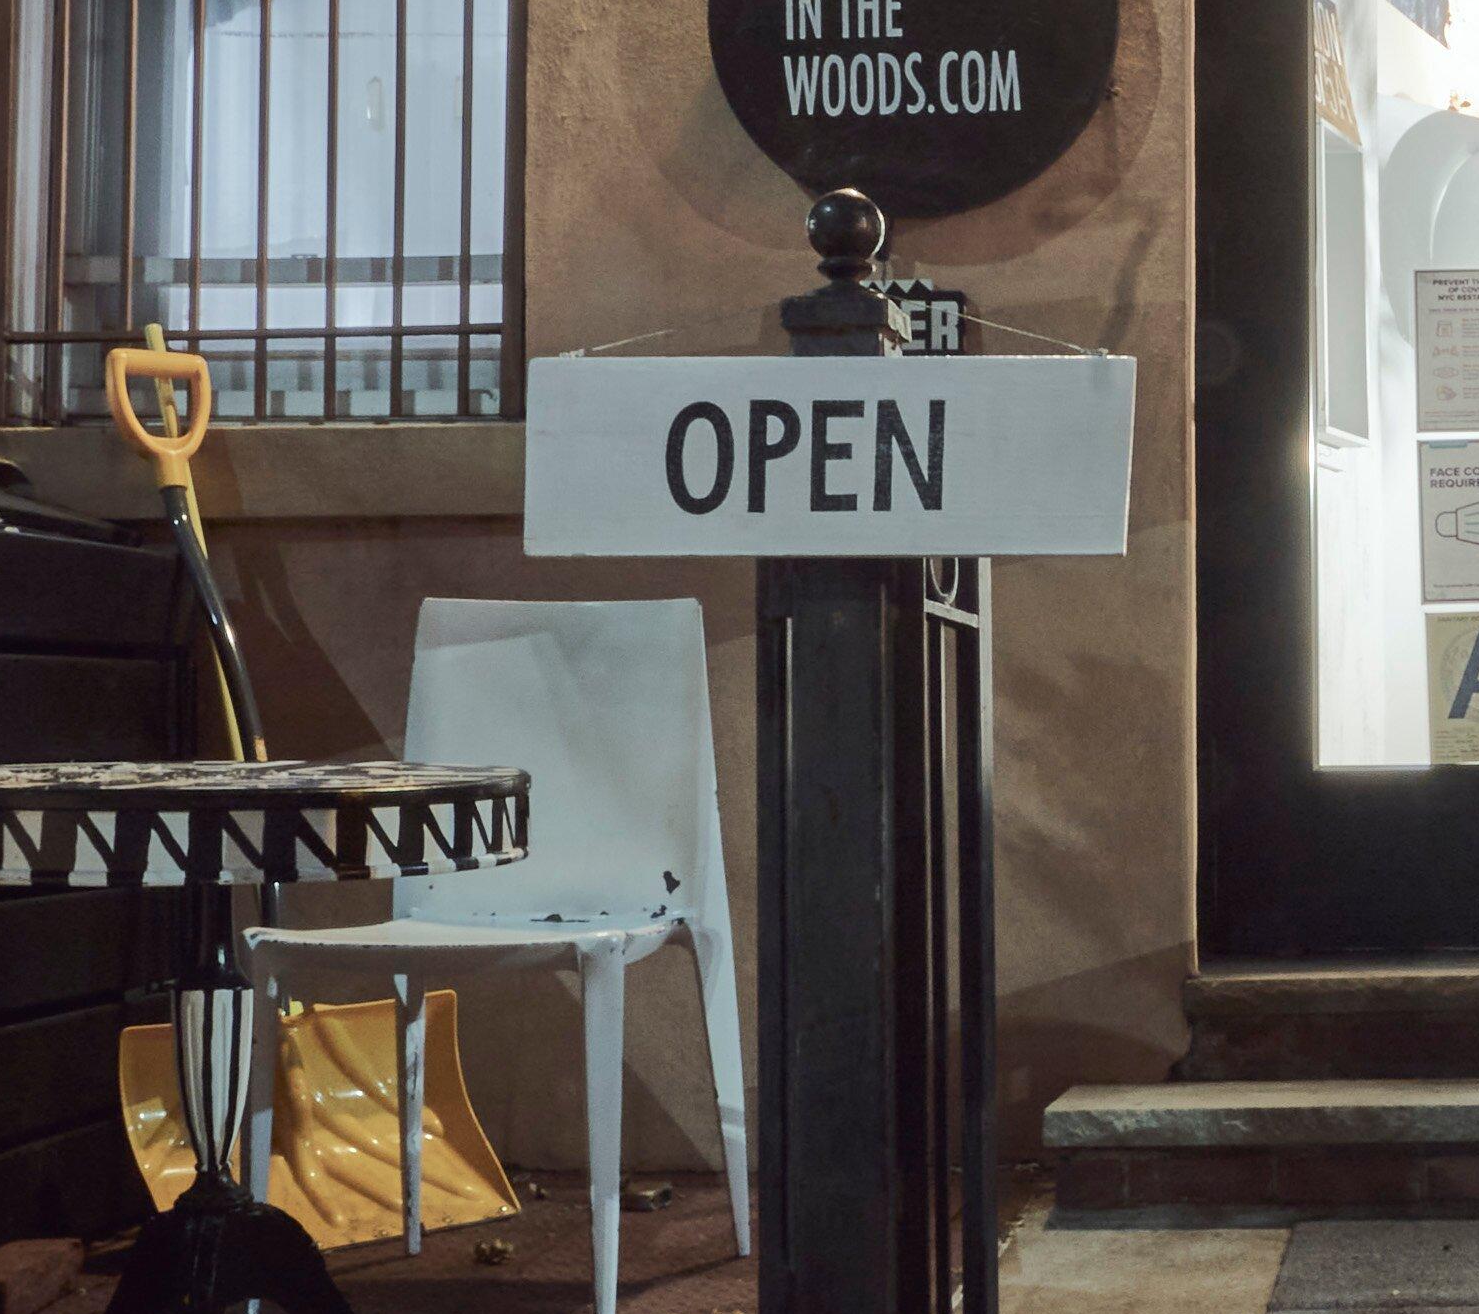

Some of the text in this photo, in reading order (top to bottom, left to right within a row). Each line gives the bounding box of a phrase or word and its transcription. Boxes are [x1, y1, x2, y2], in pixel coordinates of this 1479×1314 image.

[783, 50, 1021, 117] WOODS.COM
[664, 399, 947, 515] OPEN
[1430, 467, 1460, 476] FACE
